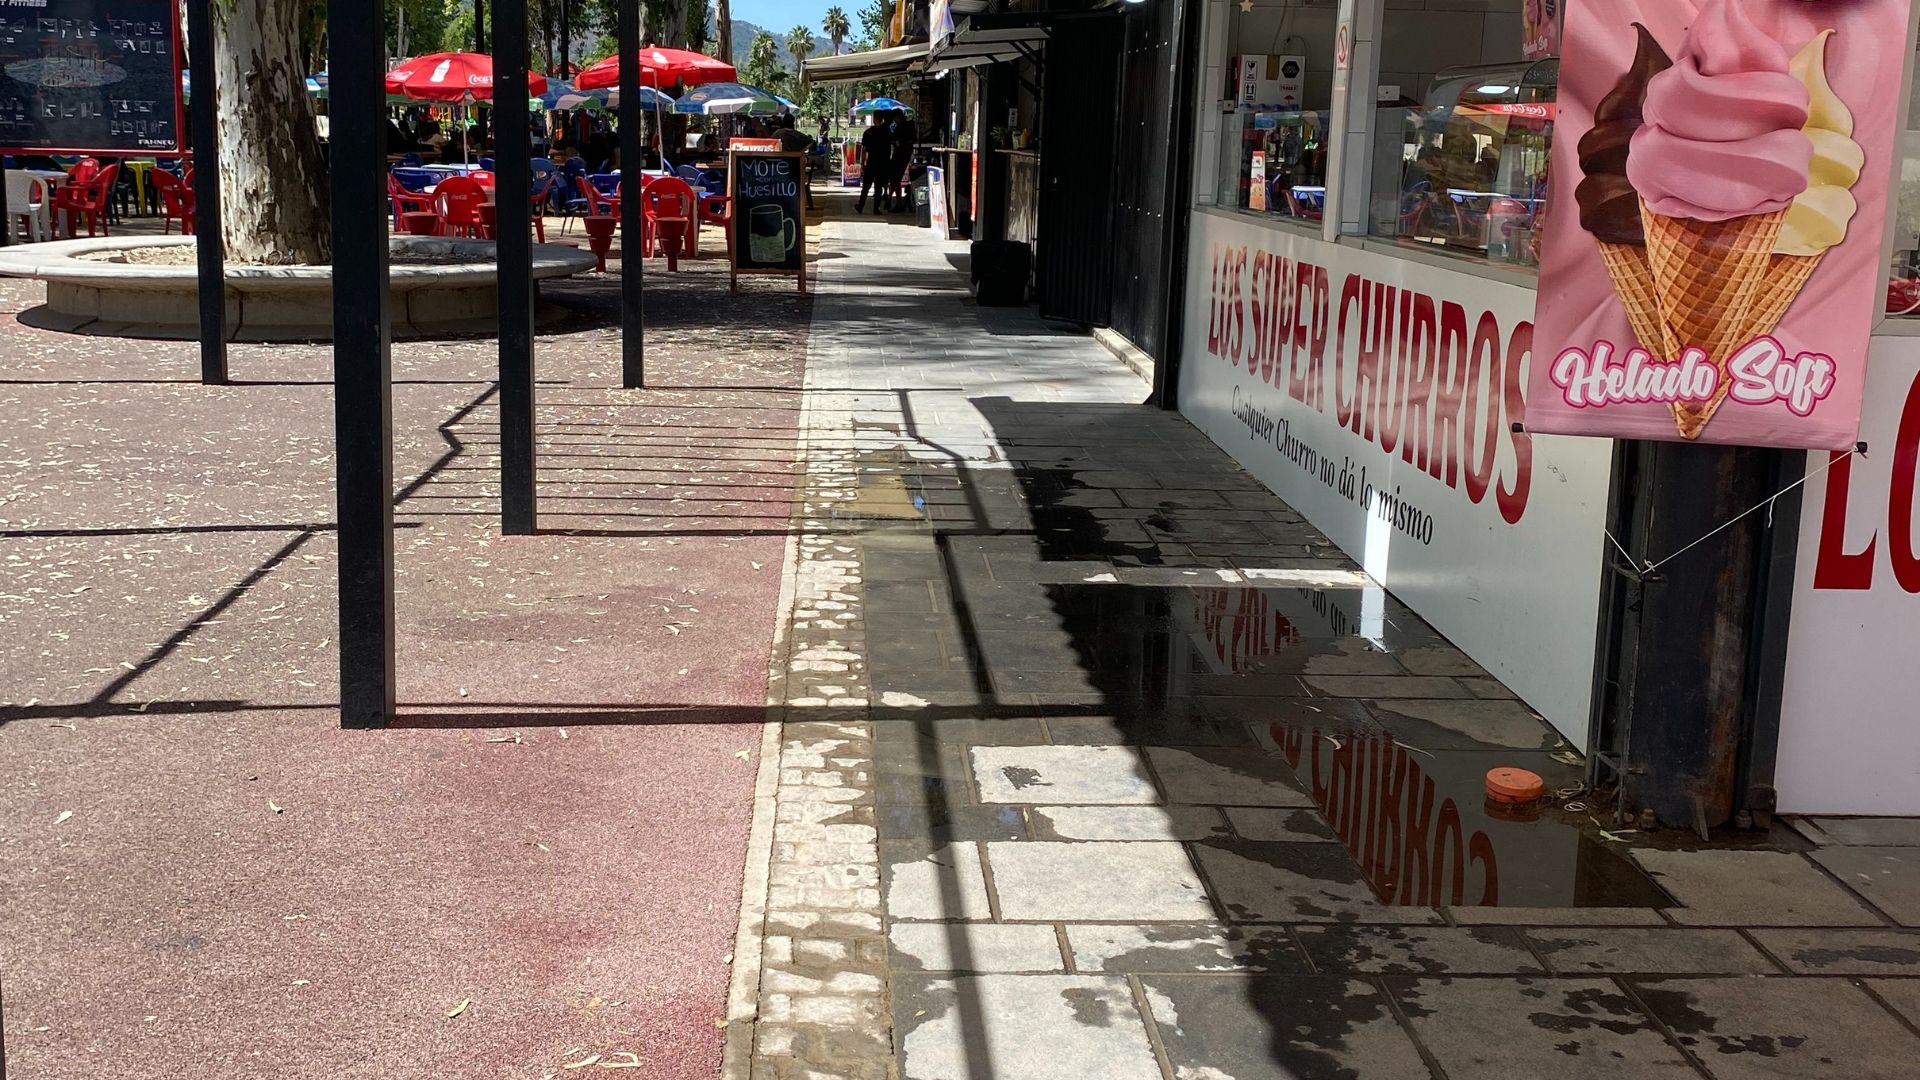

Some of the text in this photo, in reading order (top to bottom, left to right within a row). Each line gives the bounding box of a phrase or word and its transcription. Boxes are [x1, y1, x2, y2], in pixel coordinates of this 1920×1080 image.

[1208, 243, 1534, 524] LOS SUPER CHURROS
[1552, 337, 1833, 414] Helado Soft
[1231, 384, 1433, 546] Cualquier Churro no dá lo mismo
